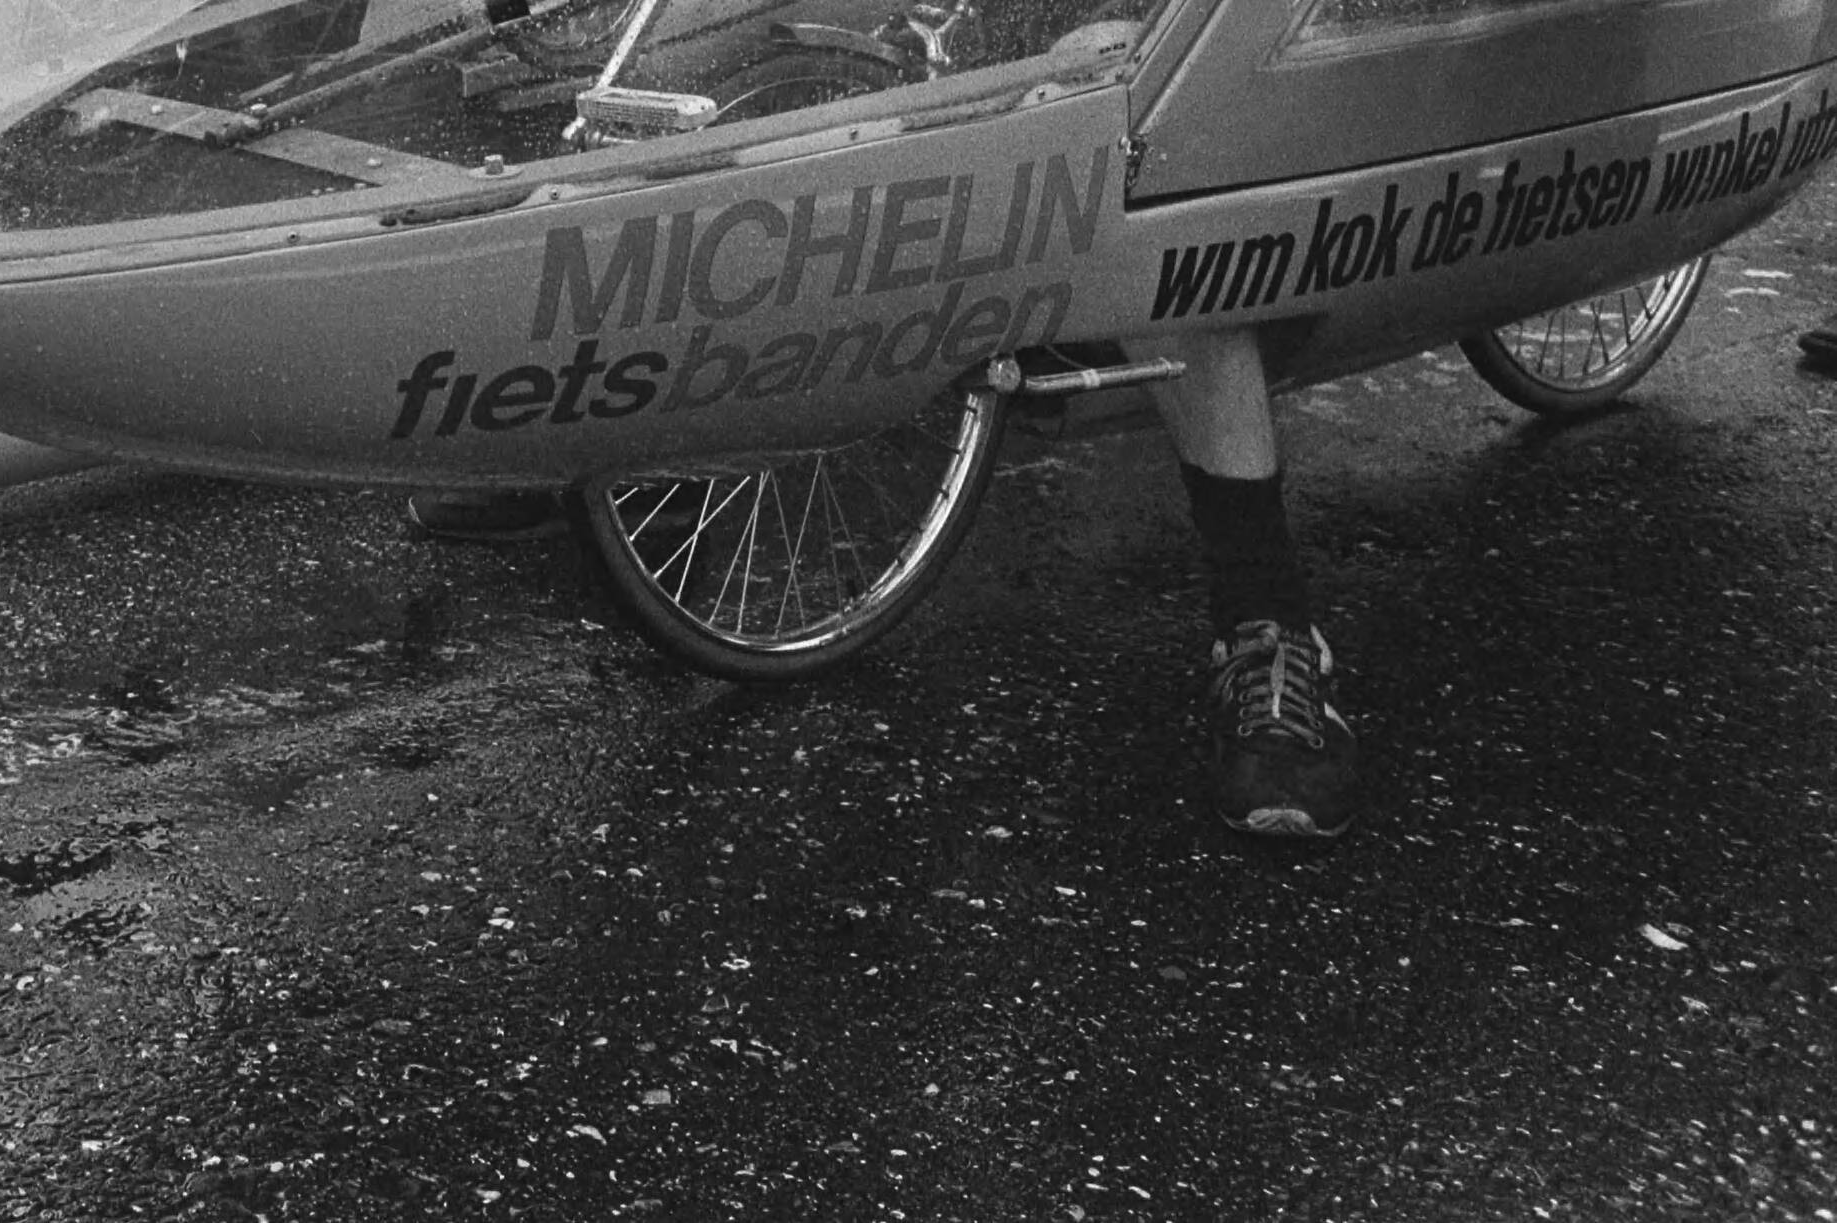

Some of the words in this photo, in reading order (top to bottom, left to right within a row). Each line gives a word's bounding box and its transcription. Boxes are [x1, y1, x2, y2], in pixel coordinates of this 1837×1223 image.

[530, 146, 1108, 342] MICHELIN
[1149, 230, 1296, 321] wim
[1294, 185, 1414, 296] kok
[1411, 171, 1483, 271] de
[1480, 147, 1651, 256] fietsen
[1653, 100, 1792, 216] winkel
